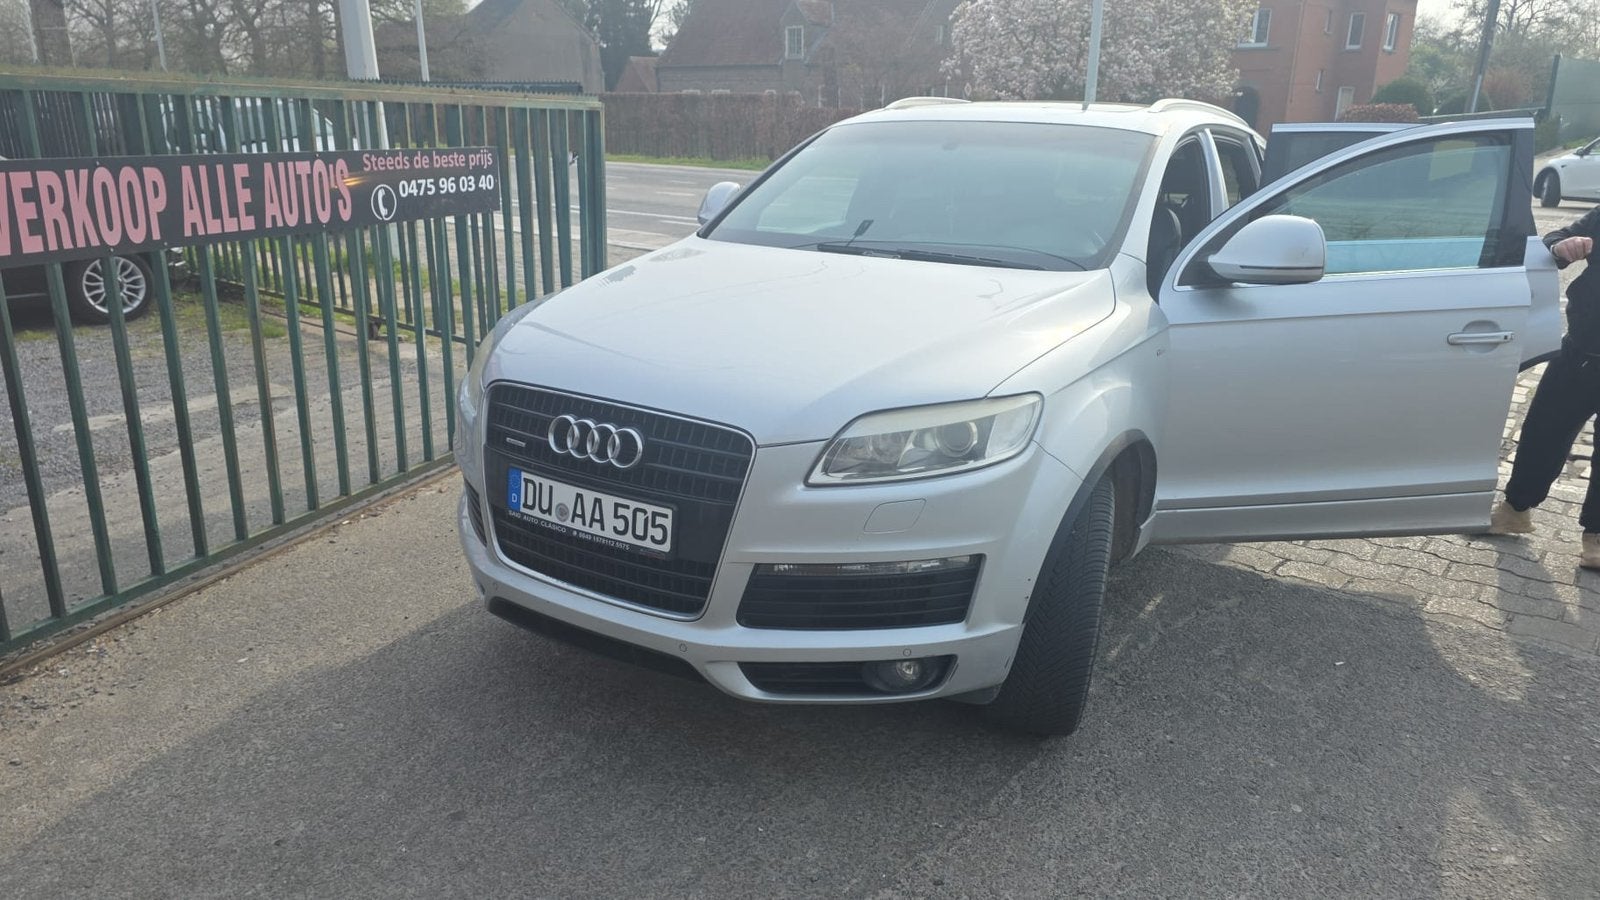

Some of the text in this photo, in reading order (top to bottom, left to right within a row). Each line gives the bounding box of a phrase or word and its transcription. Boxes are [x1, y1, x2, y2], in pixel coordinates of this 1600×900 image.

[362, 149, 493, 171] Steeds de beste prijs
[181, 163, 256, 237] ALLE
[263, 158, 352, 228] AUTO'S
[398, 174, 494, 198] 0475 96 03 40
[511, 493, 517, 503] D
[522, 478, 668, 545] DU AA 505
[523, 515, 538, 524] AUTO
